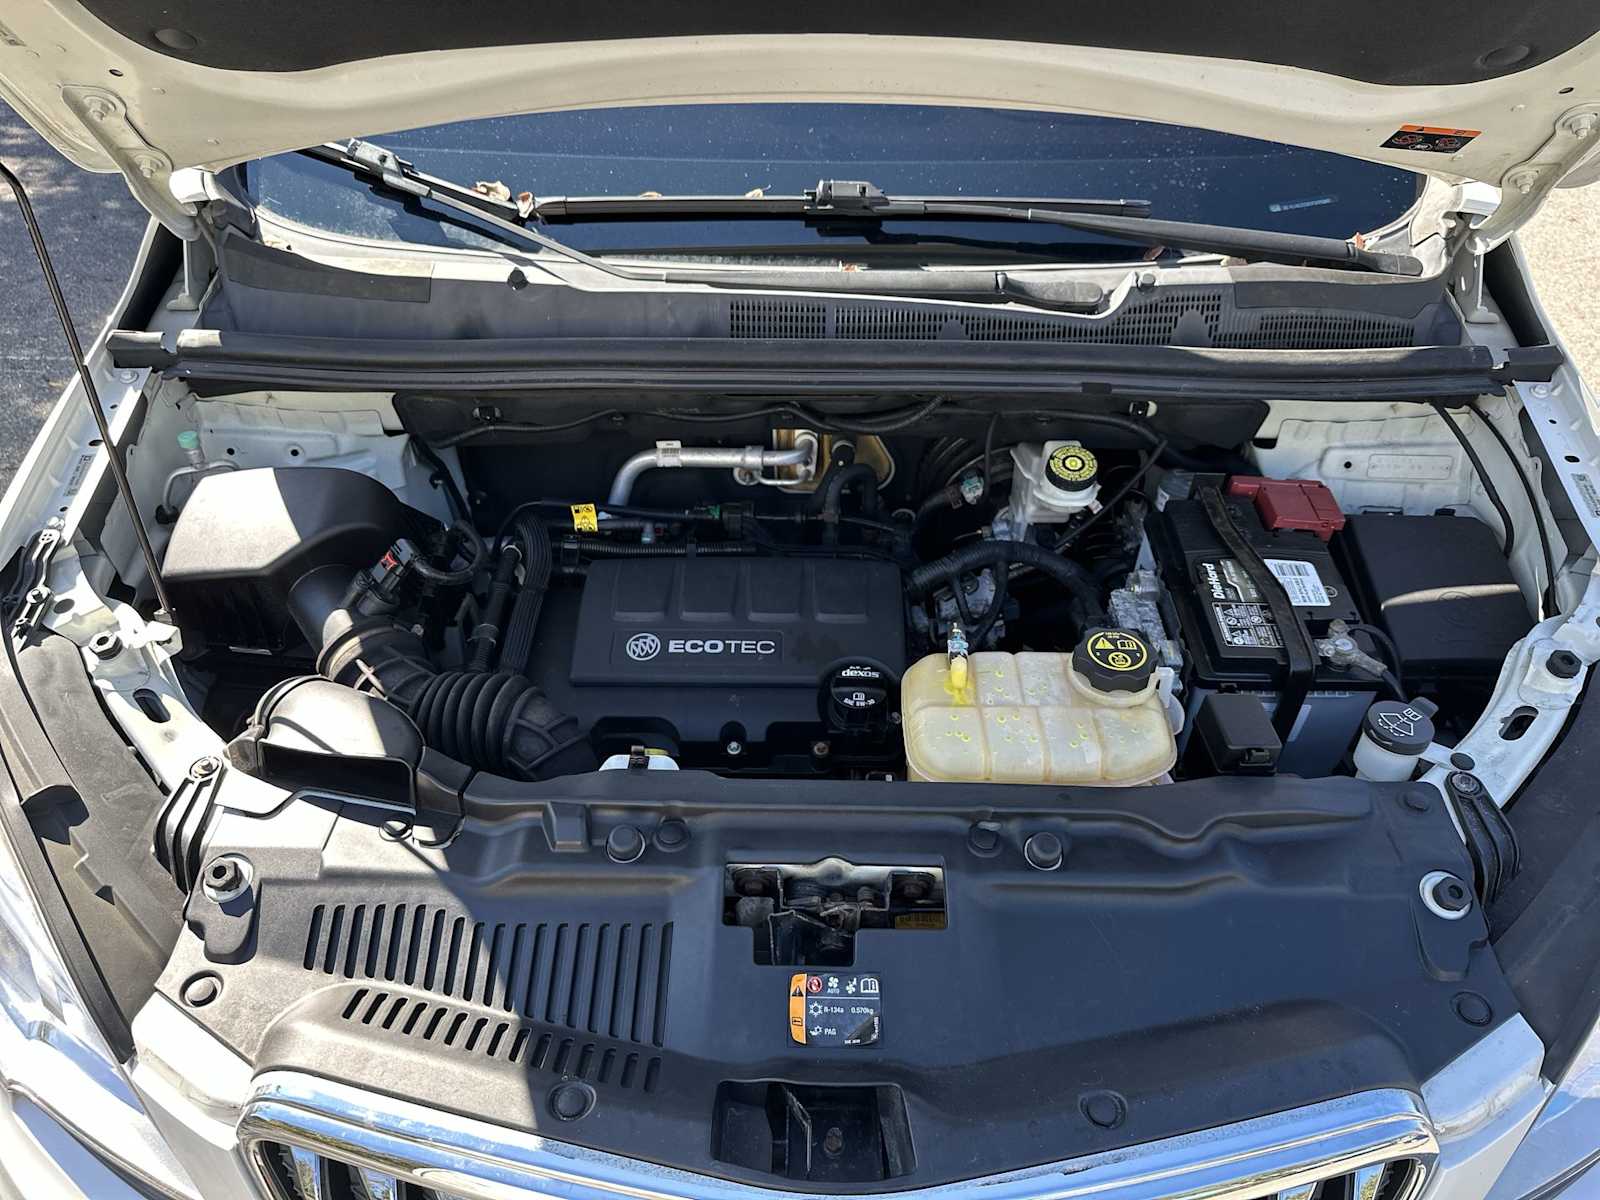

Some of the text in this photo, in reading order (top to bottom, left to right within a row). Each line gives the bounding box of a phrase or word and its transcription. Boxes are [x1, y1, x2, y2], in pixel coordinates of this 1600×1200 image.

[1202, 563, 1225, 599] DieHard
[668, 639, 775, 654] ECOTEC
[841, 669, 880, 678] dexos
[851, 1007, 874, 1015] 0.570kg
